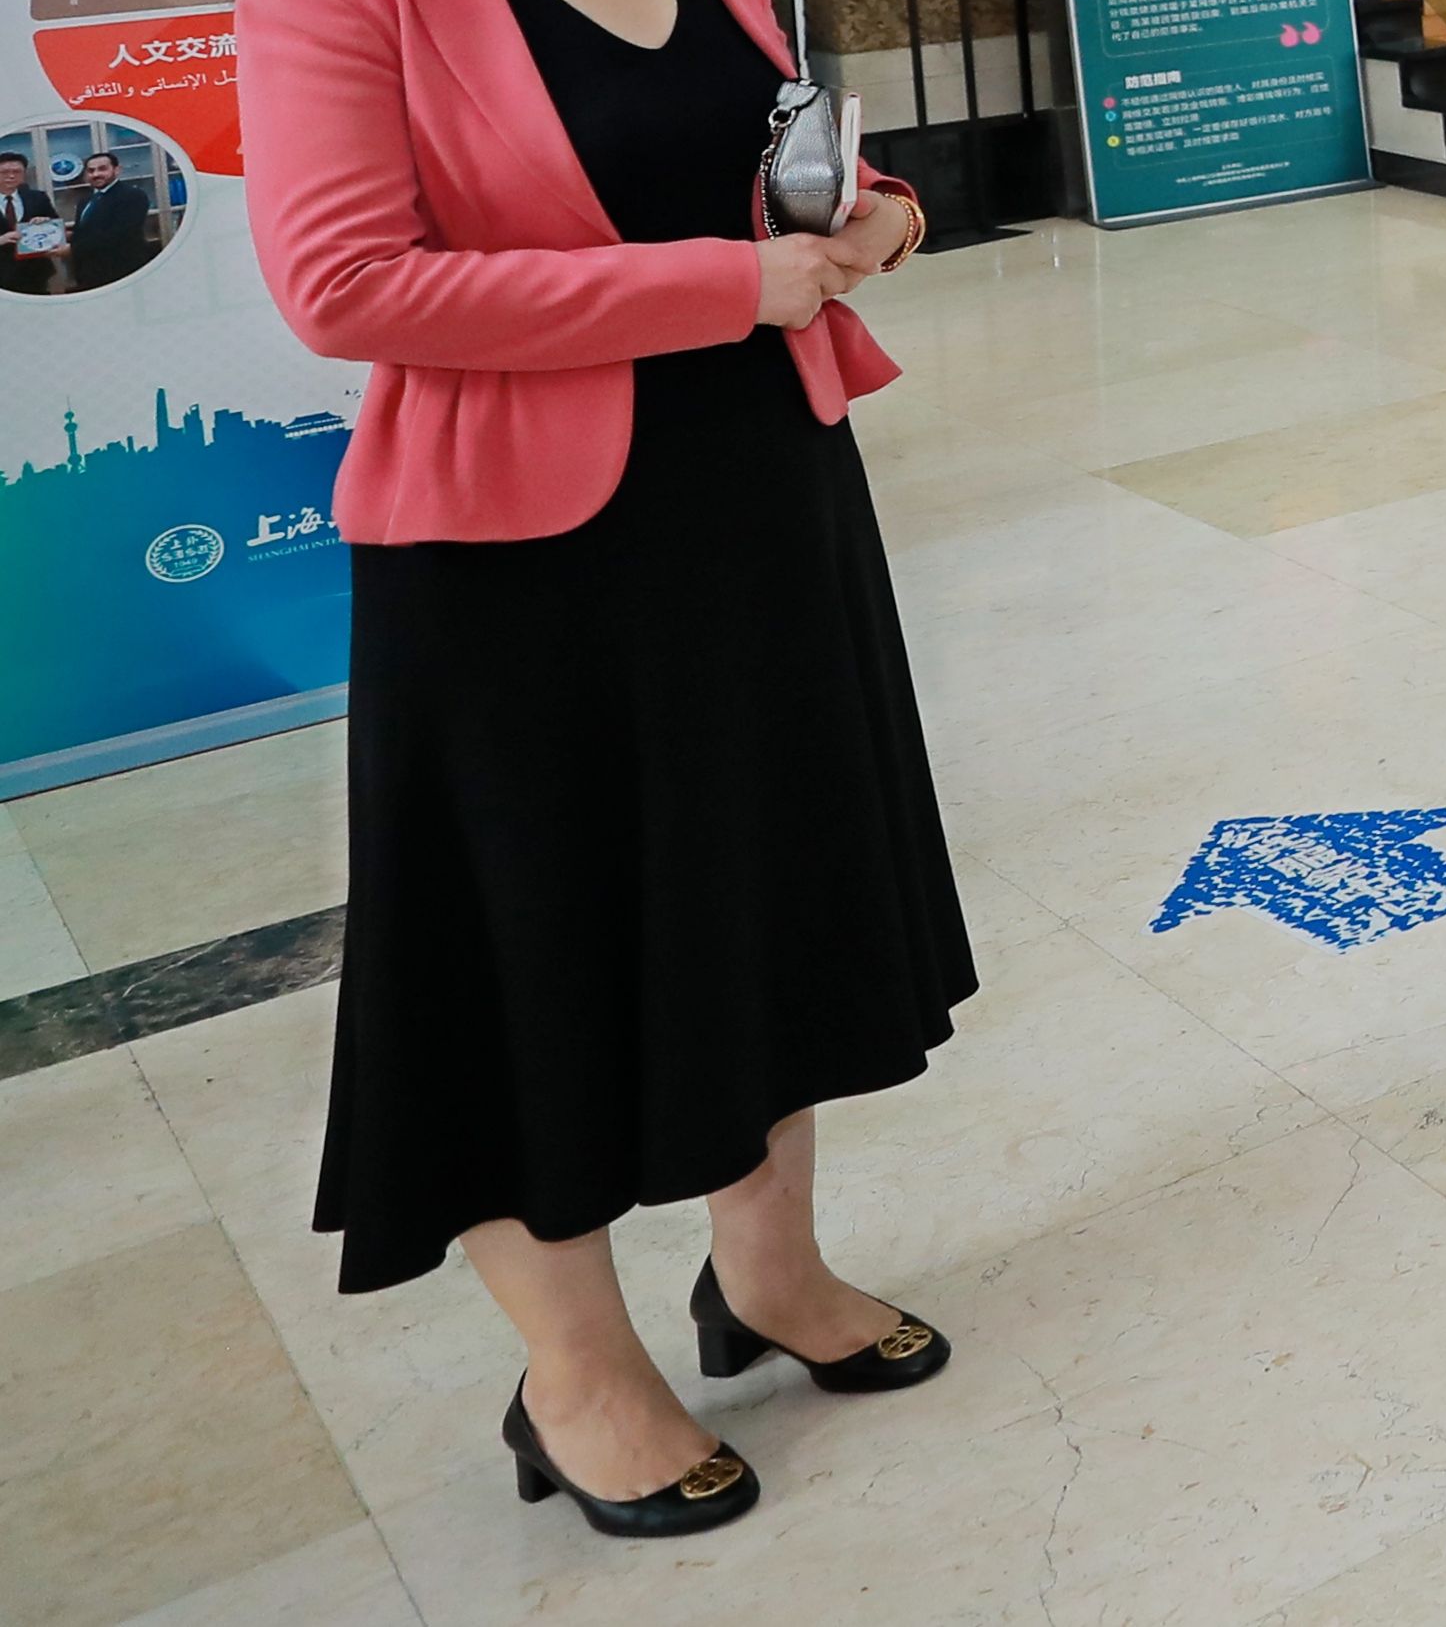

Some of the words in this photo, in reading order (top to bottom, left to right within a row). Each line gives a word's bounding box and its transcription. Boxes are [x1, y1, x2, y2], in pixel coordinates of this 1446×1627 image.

[108, 33, 238, 69] 人文交流
[1125, 70, 1182, 90] 防范指南
